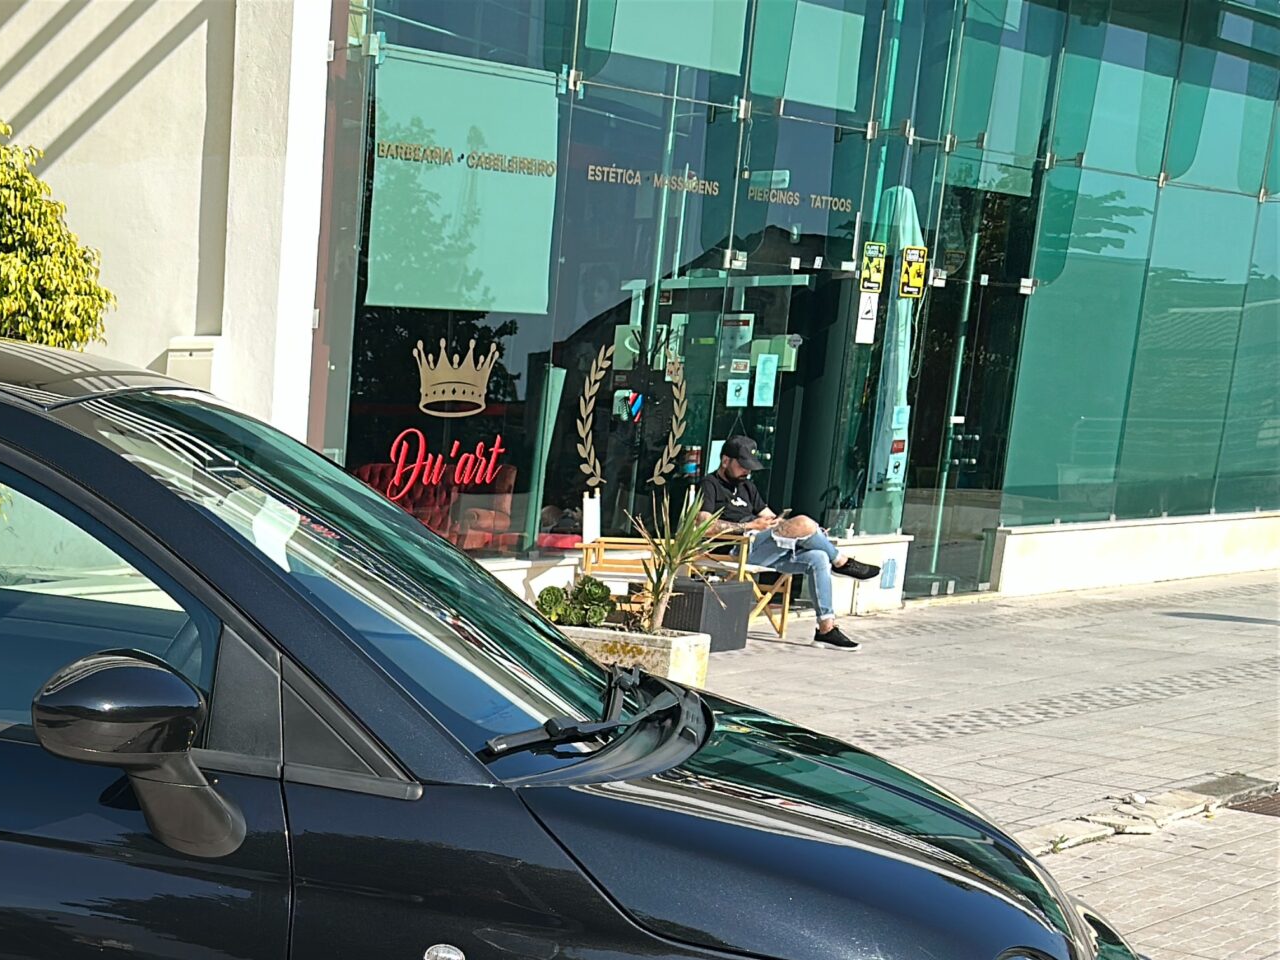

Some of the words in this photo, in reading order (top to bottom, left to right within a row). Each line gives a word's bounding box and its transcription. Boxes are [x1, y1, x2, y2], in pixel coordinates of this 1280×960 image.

[376, 142, 454, 166] BARBEARIA
[466, 150, 557, 178] CABELEIREIRO
[587, 163, 641, 186] ESTÉTICA
[653, 173, 719, 196] MASSAGENS
[748, 187, 800, 206] PIERCINGS
[810, 194, 852, 213] TATTOOS
[386, 428, 506, 500] Du'art
